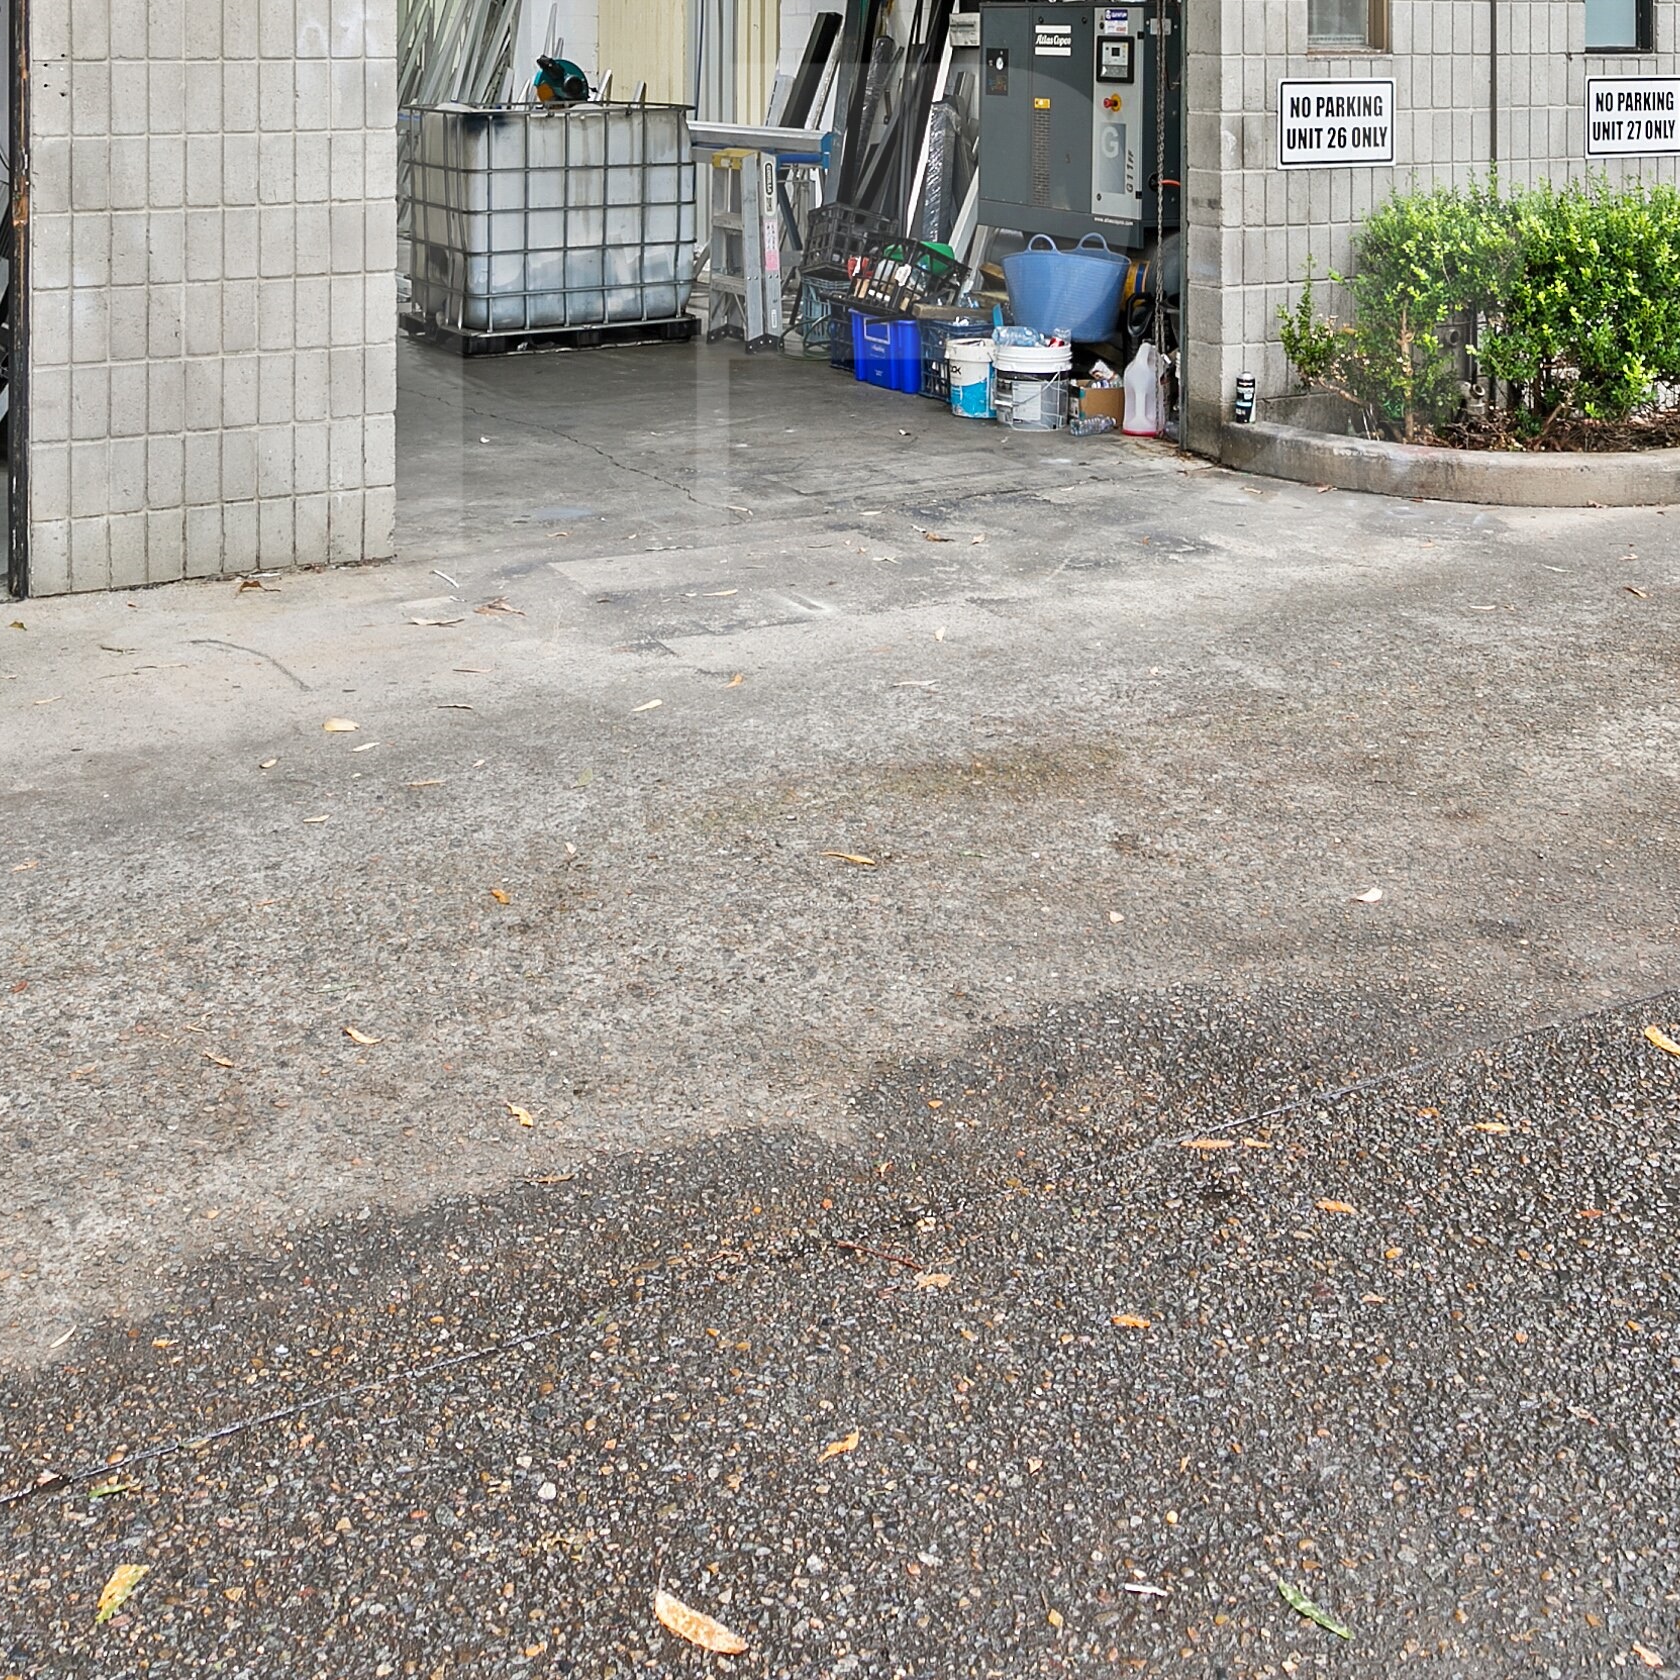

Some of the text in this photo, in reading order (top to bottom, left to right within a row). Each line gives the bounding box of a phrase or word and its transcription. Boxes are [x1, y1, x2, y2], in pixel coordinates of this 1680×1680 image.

[1290, 95, 1383, 118] NO PARKING
[1596, 91, 1674, 112] NO PARKING
[1286, 125, 1388, 150] UNIT 26 ONLY
[1592, 119, 1676, 141] UNIT 27 ONLY
[1101, 126, 1119, 158] G
